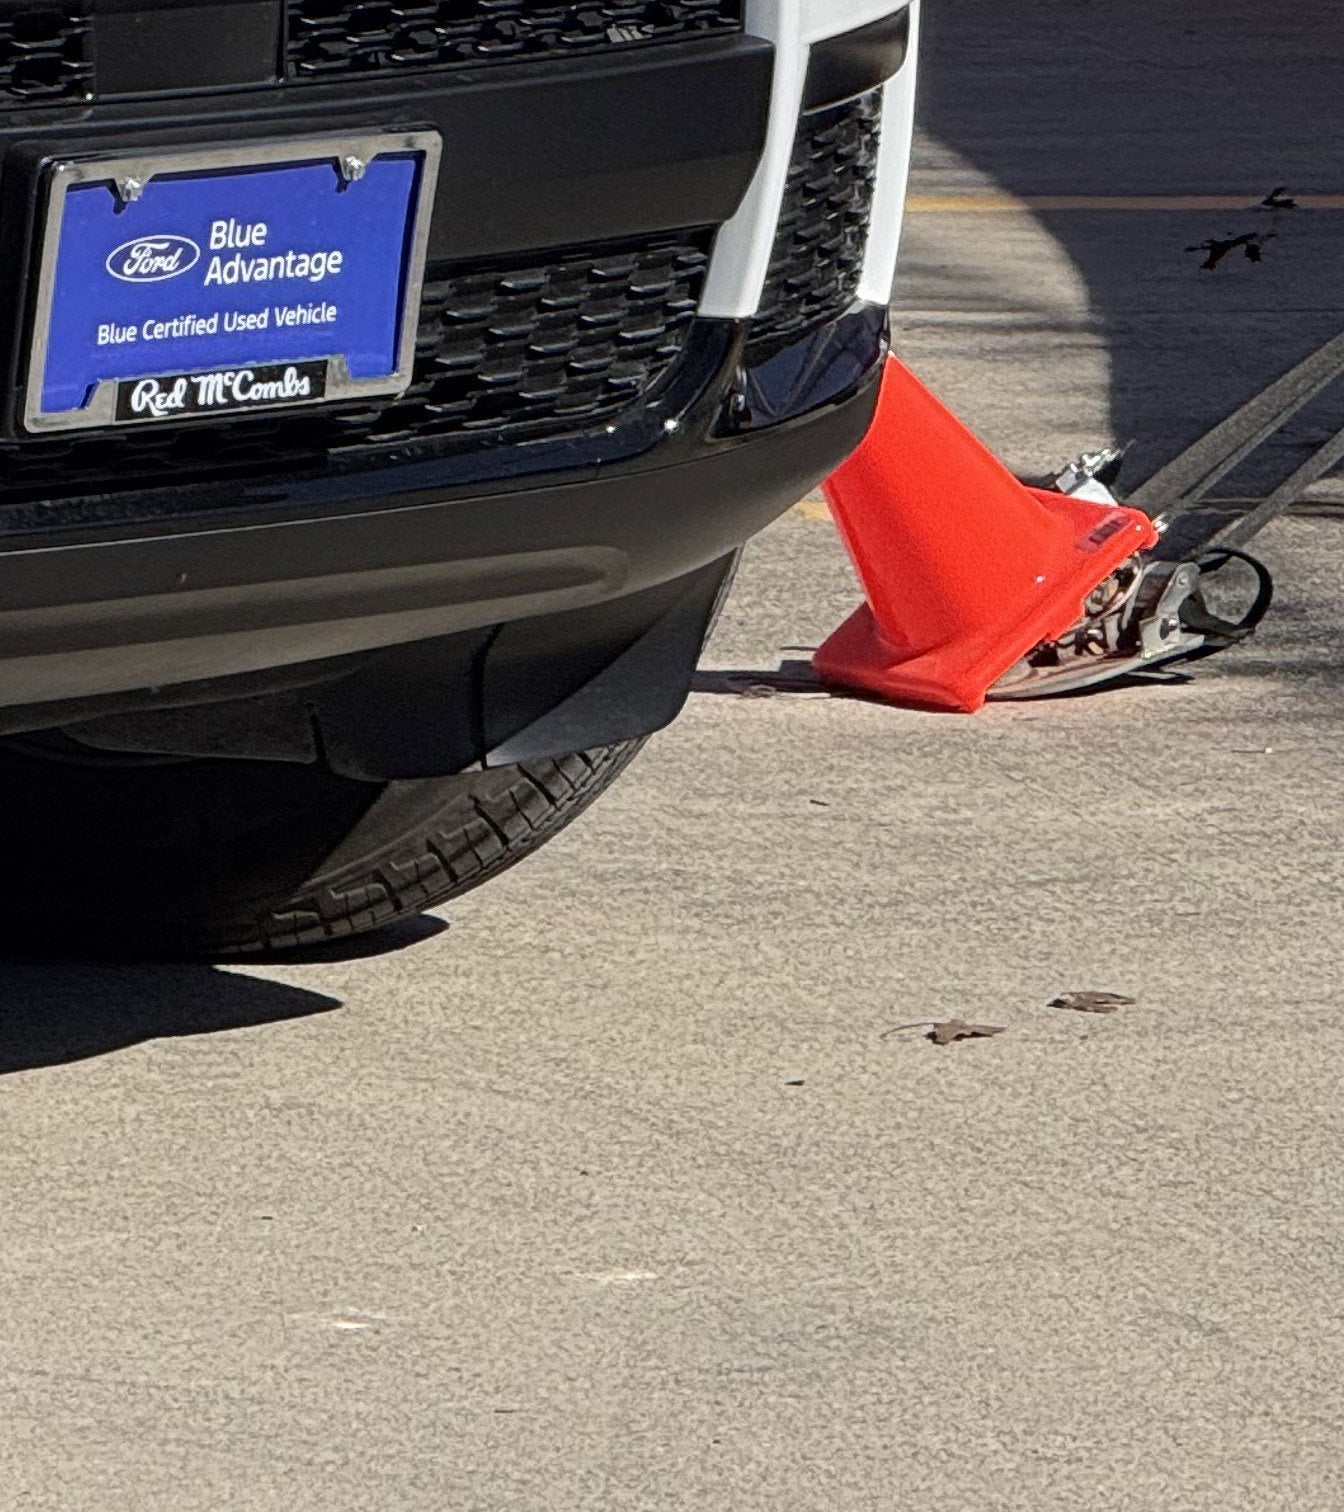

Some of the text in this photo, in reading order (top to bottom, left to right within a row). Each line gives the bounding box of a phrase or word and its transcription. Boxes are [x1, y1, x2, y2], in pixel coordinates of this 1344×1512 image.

[210, 218, 268, 250] Blue
[123, 242, 183, 275] Ford
[204, 249, 343, 286] Advantage
[97, 302, 337, 345] Blue Certified Used Vehicle
[131, 367, 310, 417] Red McCombs
